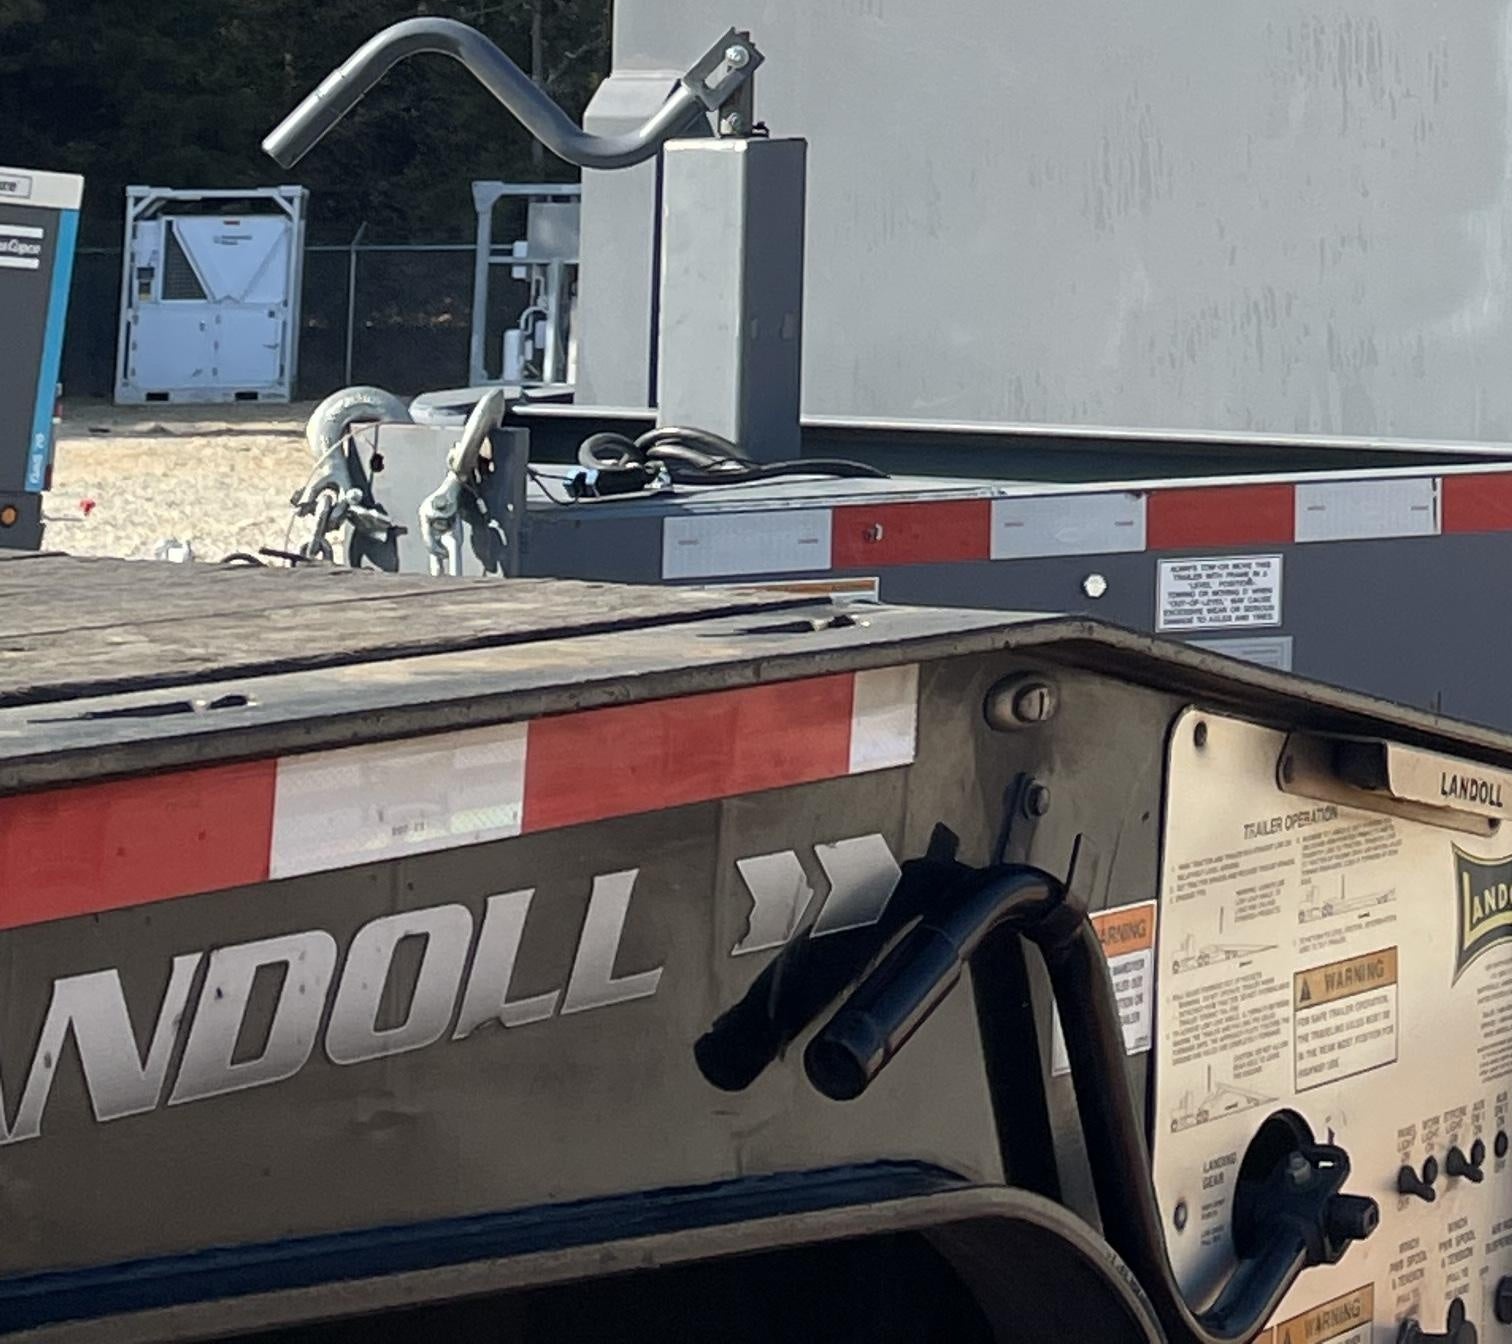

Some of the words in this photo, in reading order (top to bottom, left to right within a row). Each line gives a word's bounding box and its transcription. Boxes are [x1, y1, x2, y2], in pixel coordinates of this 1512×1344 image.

[1440, 771, 1504, 809] LANDOLL
[1323, 959, 1386, 994] WARNING
[0, 868, 664, 1146] NDOLL
